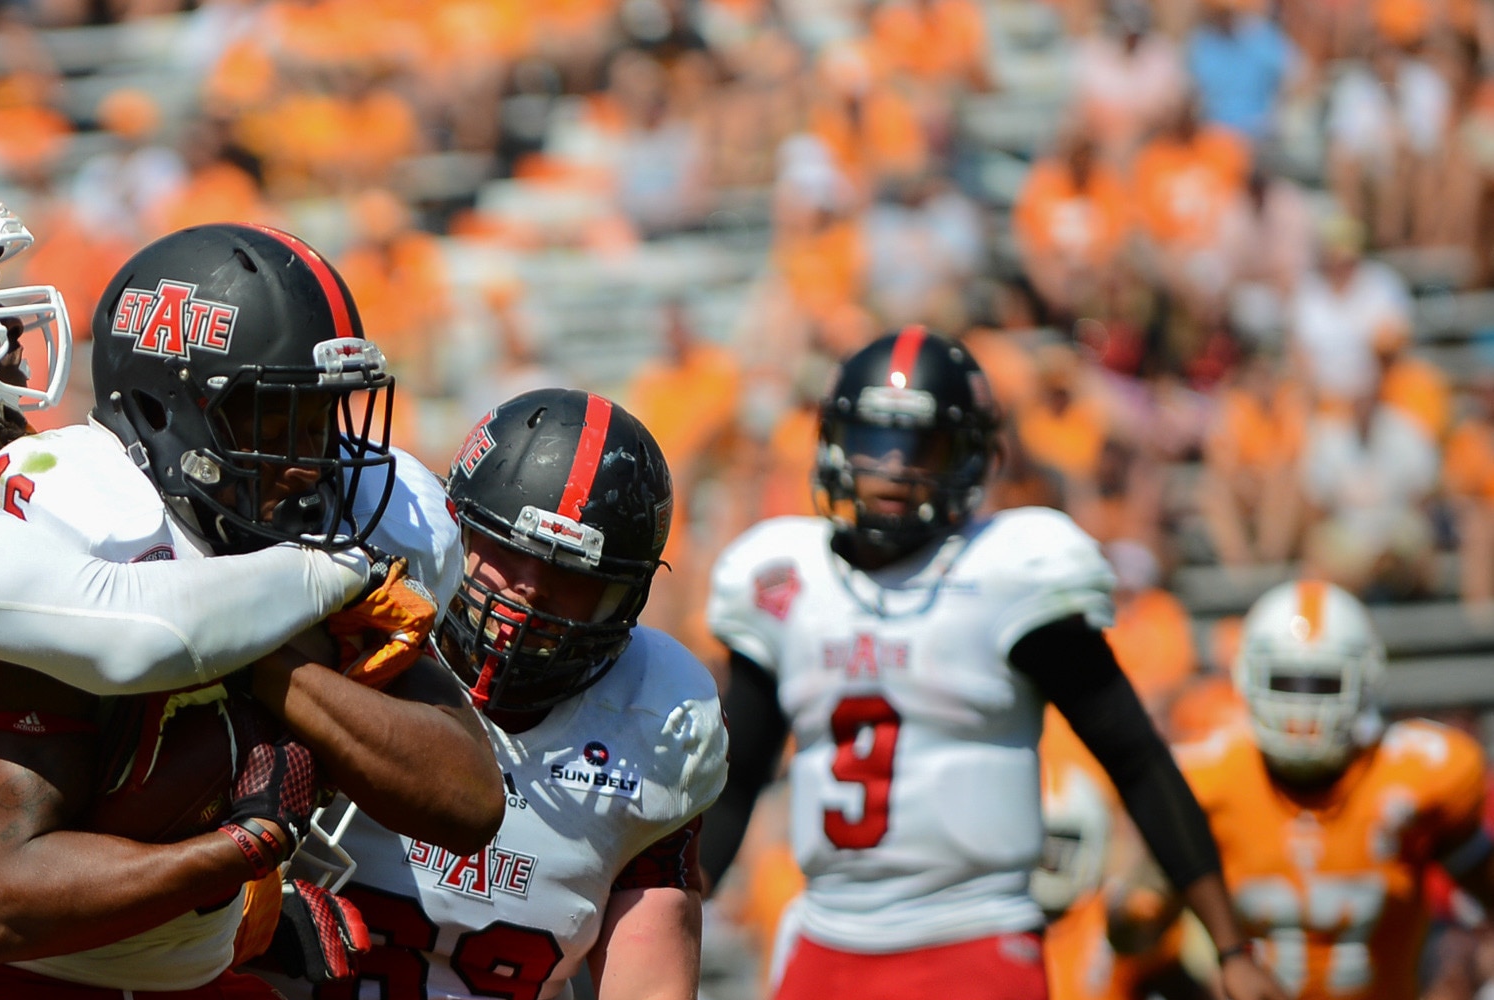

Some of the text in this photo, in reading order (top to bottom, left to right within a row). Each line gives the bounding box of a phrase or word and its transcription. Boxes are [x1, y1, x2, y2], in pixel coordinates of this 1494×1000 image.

[114, 282, 235, 355] STATE
[13, 722, 46, 732] adidas
[550, 764, 638, 791] SUN BELT
[821, 694, 903, 850] 9
[407, 838, 536, 899] STATE
